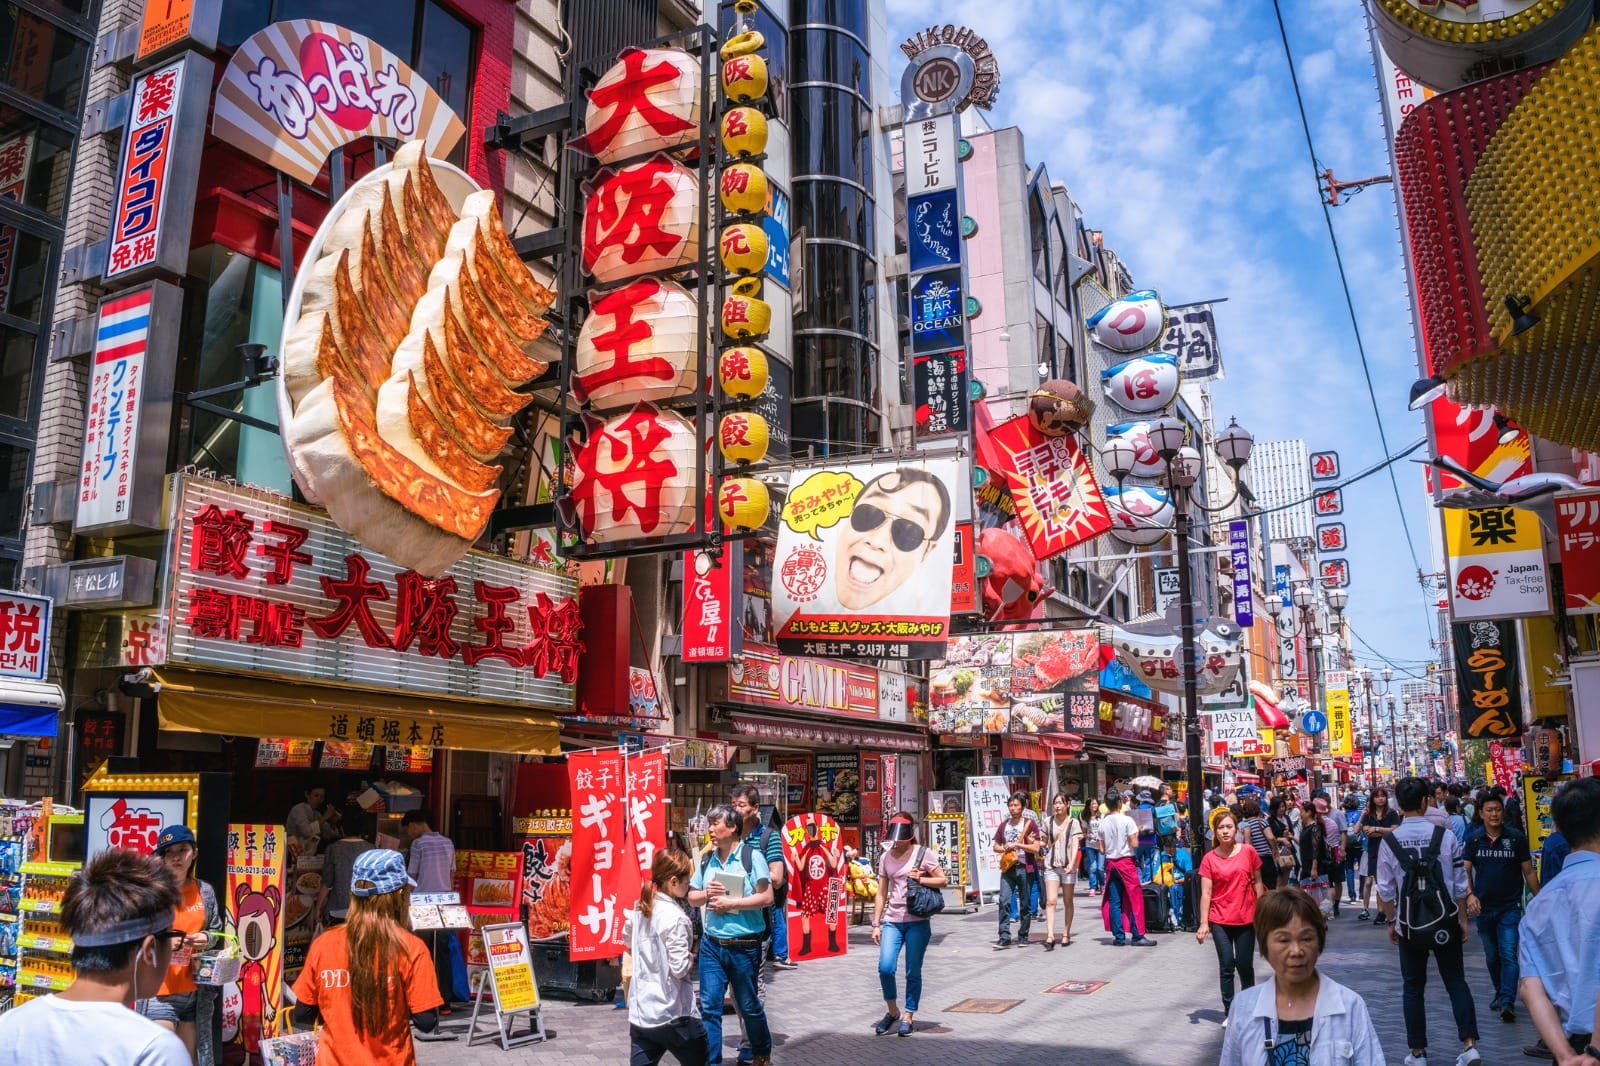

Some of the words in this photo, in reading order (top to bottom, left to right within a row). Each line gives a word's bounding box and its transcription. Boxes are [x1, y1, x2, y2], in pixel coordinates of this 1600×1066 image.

[923, 69, 950, 94] NK
[138, 71, 177, 122] 薬
[123, 121, 168, 237] ダイコク
[110, 236, 156, 274] 免税
[924, 299, 951, 314] BAR
[968, 301, 977, 312] 3
[914, 315, 962, 333] OCEAN
[972, 384, 980, 396] 2
[103, 359, 127, 481] クンテープ
[117, 365, 138, 498] タイ料理とタイスキの店
[1034, 443, 1080, 528] コナモン
[116, 500, 126, 513] B1
[790, 478, 852, 516] おみやげ
[191, 503, 313, 586] 餃子
[1563, 532, 1600, 551] ドラ
[1507, 564, 1542, 574] Japan.
[1504, 575, 1544, 585] Tax-free
[1520, 585, 1545, 595] Shop
[308, 554, 588, 685] 大阪王将
[789, 620, 943, 637] よしもと芸人グッズ・大阪みやげ
[688, 646, 725, 658] 道頓堀店
[888, 644, 909, 658] 선물
[0, 652, 38, 673] 면세
[1141, 654, 1226, 679] づぼや
[781, 656, 849, 711] GAME
[1467, 648, 1518, 737] らーめん
[1215, 712, 1254, 723] PASTA
[329, 716, 446, 748] 道頓堀本店
[1217, 728, 1254, 739] PIZZA
[1244, 743, 1257, 752] 2F
[575, 768, 613, 790] 餃子
[981, 790, 1009, 808] 串カツ
[228, 831, 277, 853] 阪王将
[789, 822, 837, 847] アホ
[1475, 849, 1515, 858] ALIFORNIA
[522, 839, 553, 902] 餃子
[578, 793, 618, 944] ギョーザ
[504, 931, 513, 941] 1F
